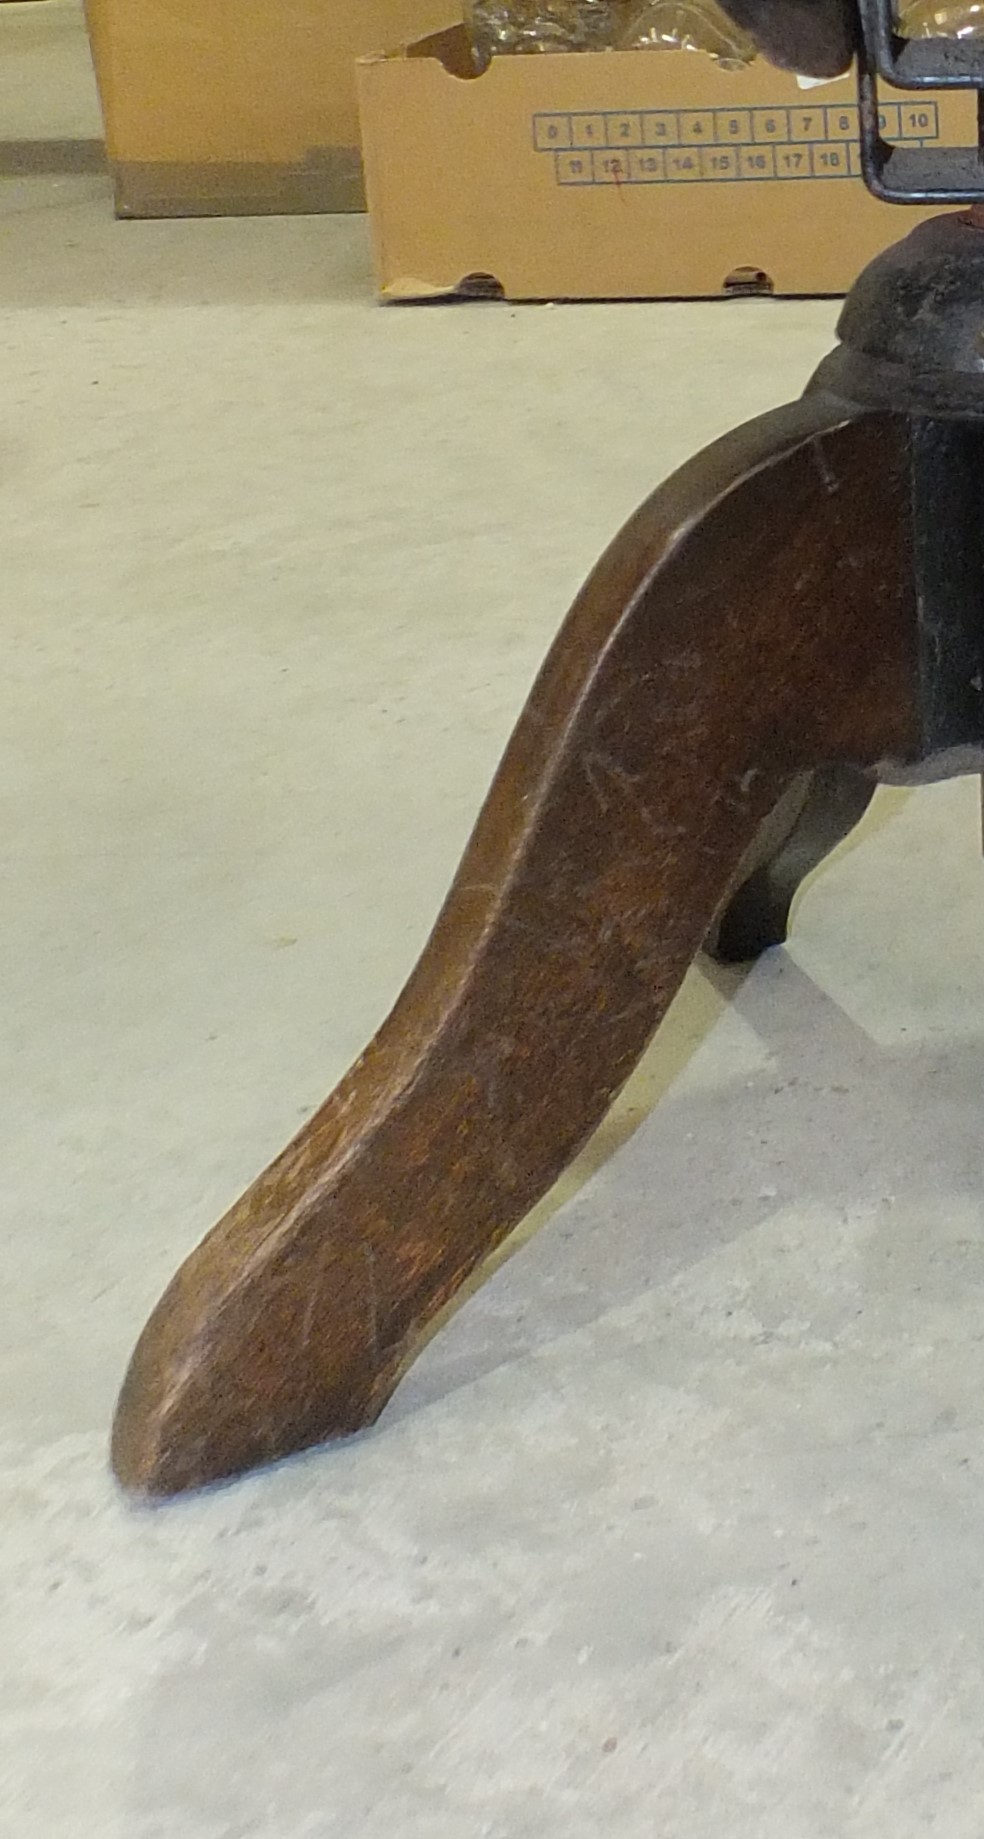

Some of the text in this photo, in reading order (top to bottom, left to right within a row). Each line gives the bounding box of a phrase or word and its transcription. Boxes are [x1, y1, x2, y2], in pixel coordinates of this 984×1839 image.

[584, 124, 594, 139] 1
[618, 122, 631, 138] 2
[654, 121, 667, 137] 3
[692, 120, 703, 135] 4
[728, 119, 739, 135] 5
[764, 118, 776, 134] 6
[801, 116, 813, 132] 7
[838, 115, 851, 131] 8
[908, 112, 929, 129] 10
[602, 158, 623, 174] 12
[638, 157, 659, 173] 13
[672, 156, 694, 171] 14
[710, 155, 730, 171] 15
[746, 154, 767, 170] 16
[783, 153, 803, 169] 17
[819, 151, 841, 167] 18
